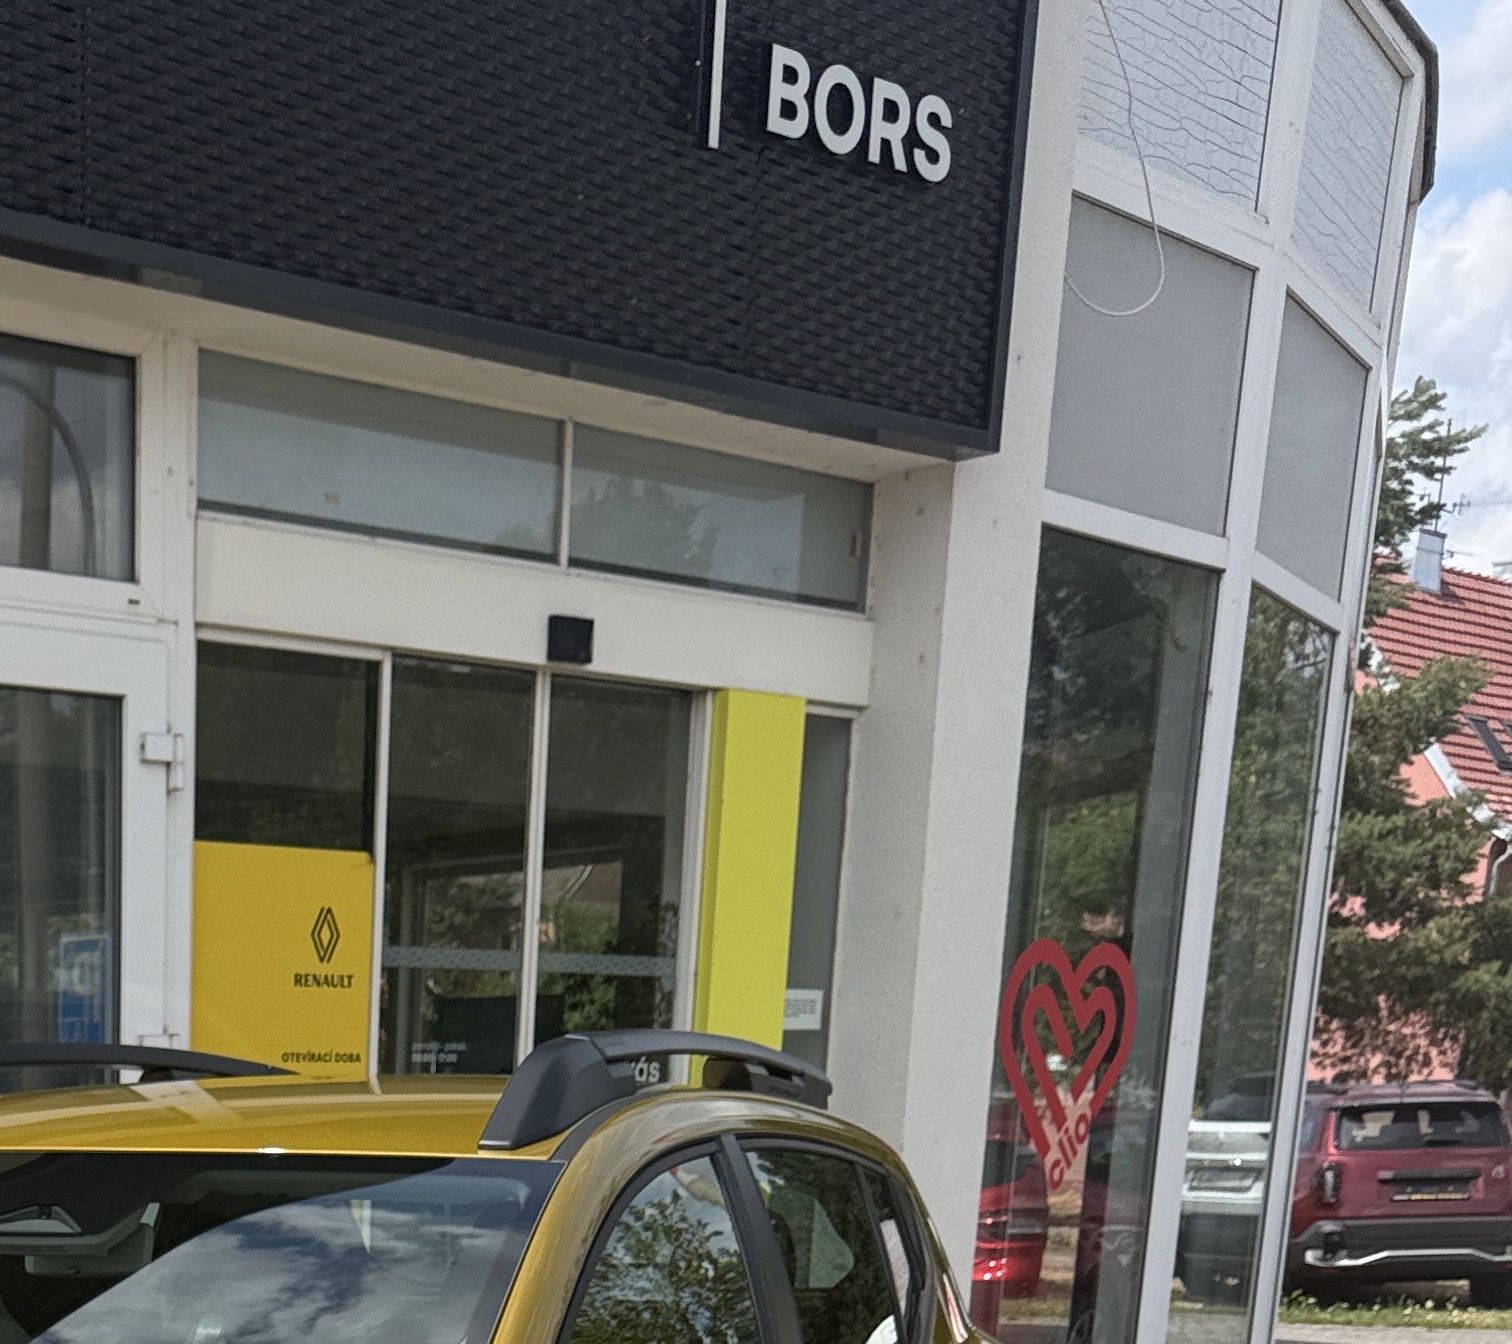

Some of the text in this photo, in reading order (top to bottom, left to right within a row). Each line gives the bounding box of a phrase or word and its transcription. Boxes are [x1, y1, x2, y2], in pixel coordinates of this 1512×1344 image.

[766, 42, 953, 183] BORS
[293, 973, 354, 988] RENAULT
[630, 1055, 660, 1082] ás
[1049, 1113, 1089, 1190] clio
